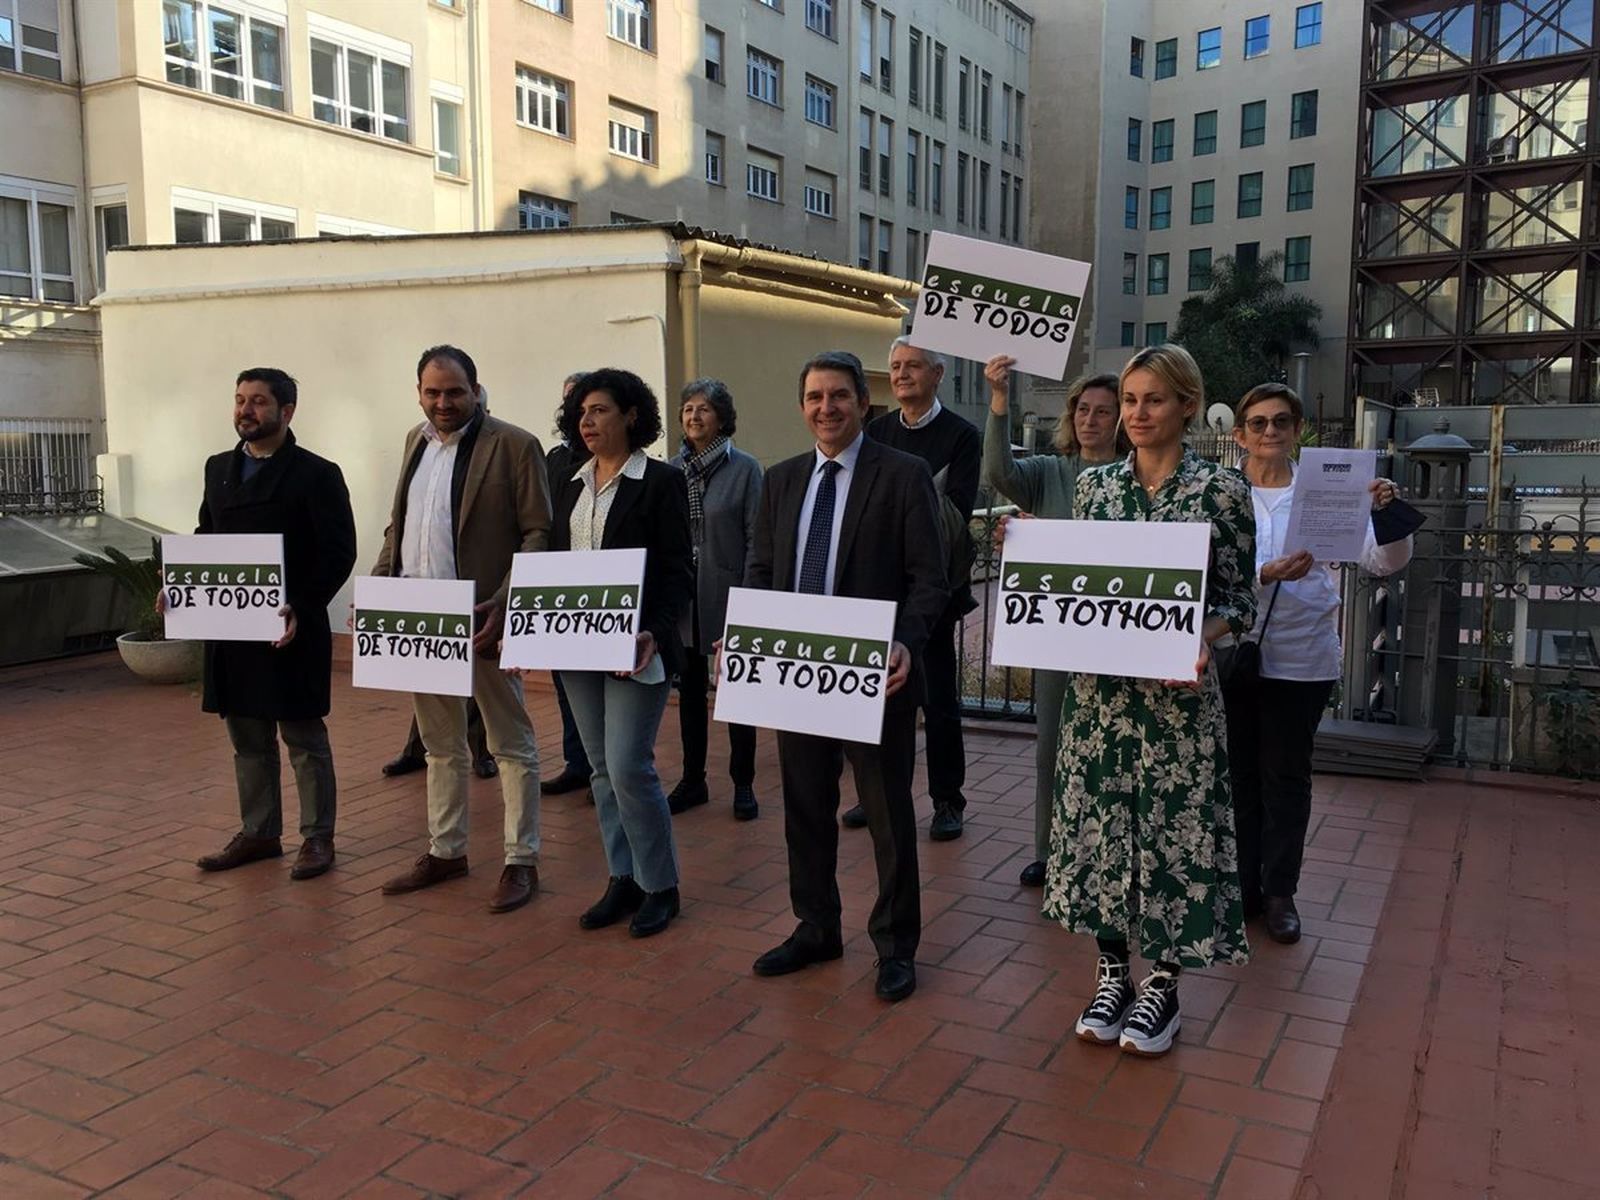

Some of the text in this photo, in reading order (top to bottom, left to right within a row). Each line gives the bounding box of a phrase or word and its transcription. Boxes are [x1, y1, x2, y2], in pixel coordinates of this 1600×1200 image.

[927, 274, 1073, 318] escuela
[924, 291, 1070, 343] DE TODOS
[167, 568, 280, 584] escuela
[1005, 572, 1193, 599] escola
[168, 586, 280, 610] DE TODOS
[511, 589, 633, 609] escola
[357, 617, 467, 636] escola
[510, 611, 633, 636] DE TOTHOM
[1005, 593, 1195, 635] DE TOTHOM
[357, 633, 468, 662] DE TOTHOM
[727, 635, 883, 667] escuela
[726, 654, 881, 698] DE TODOS
